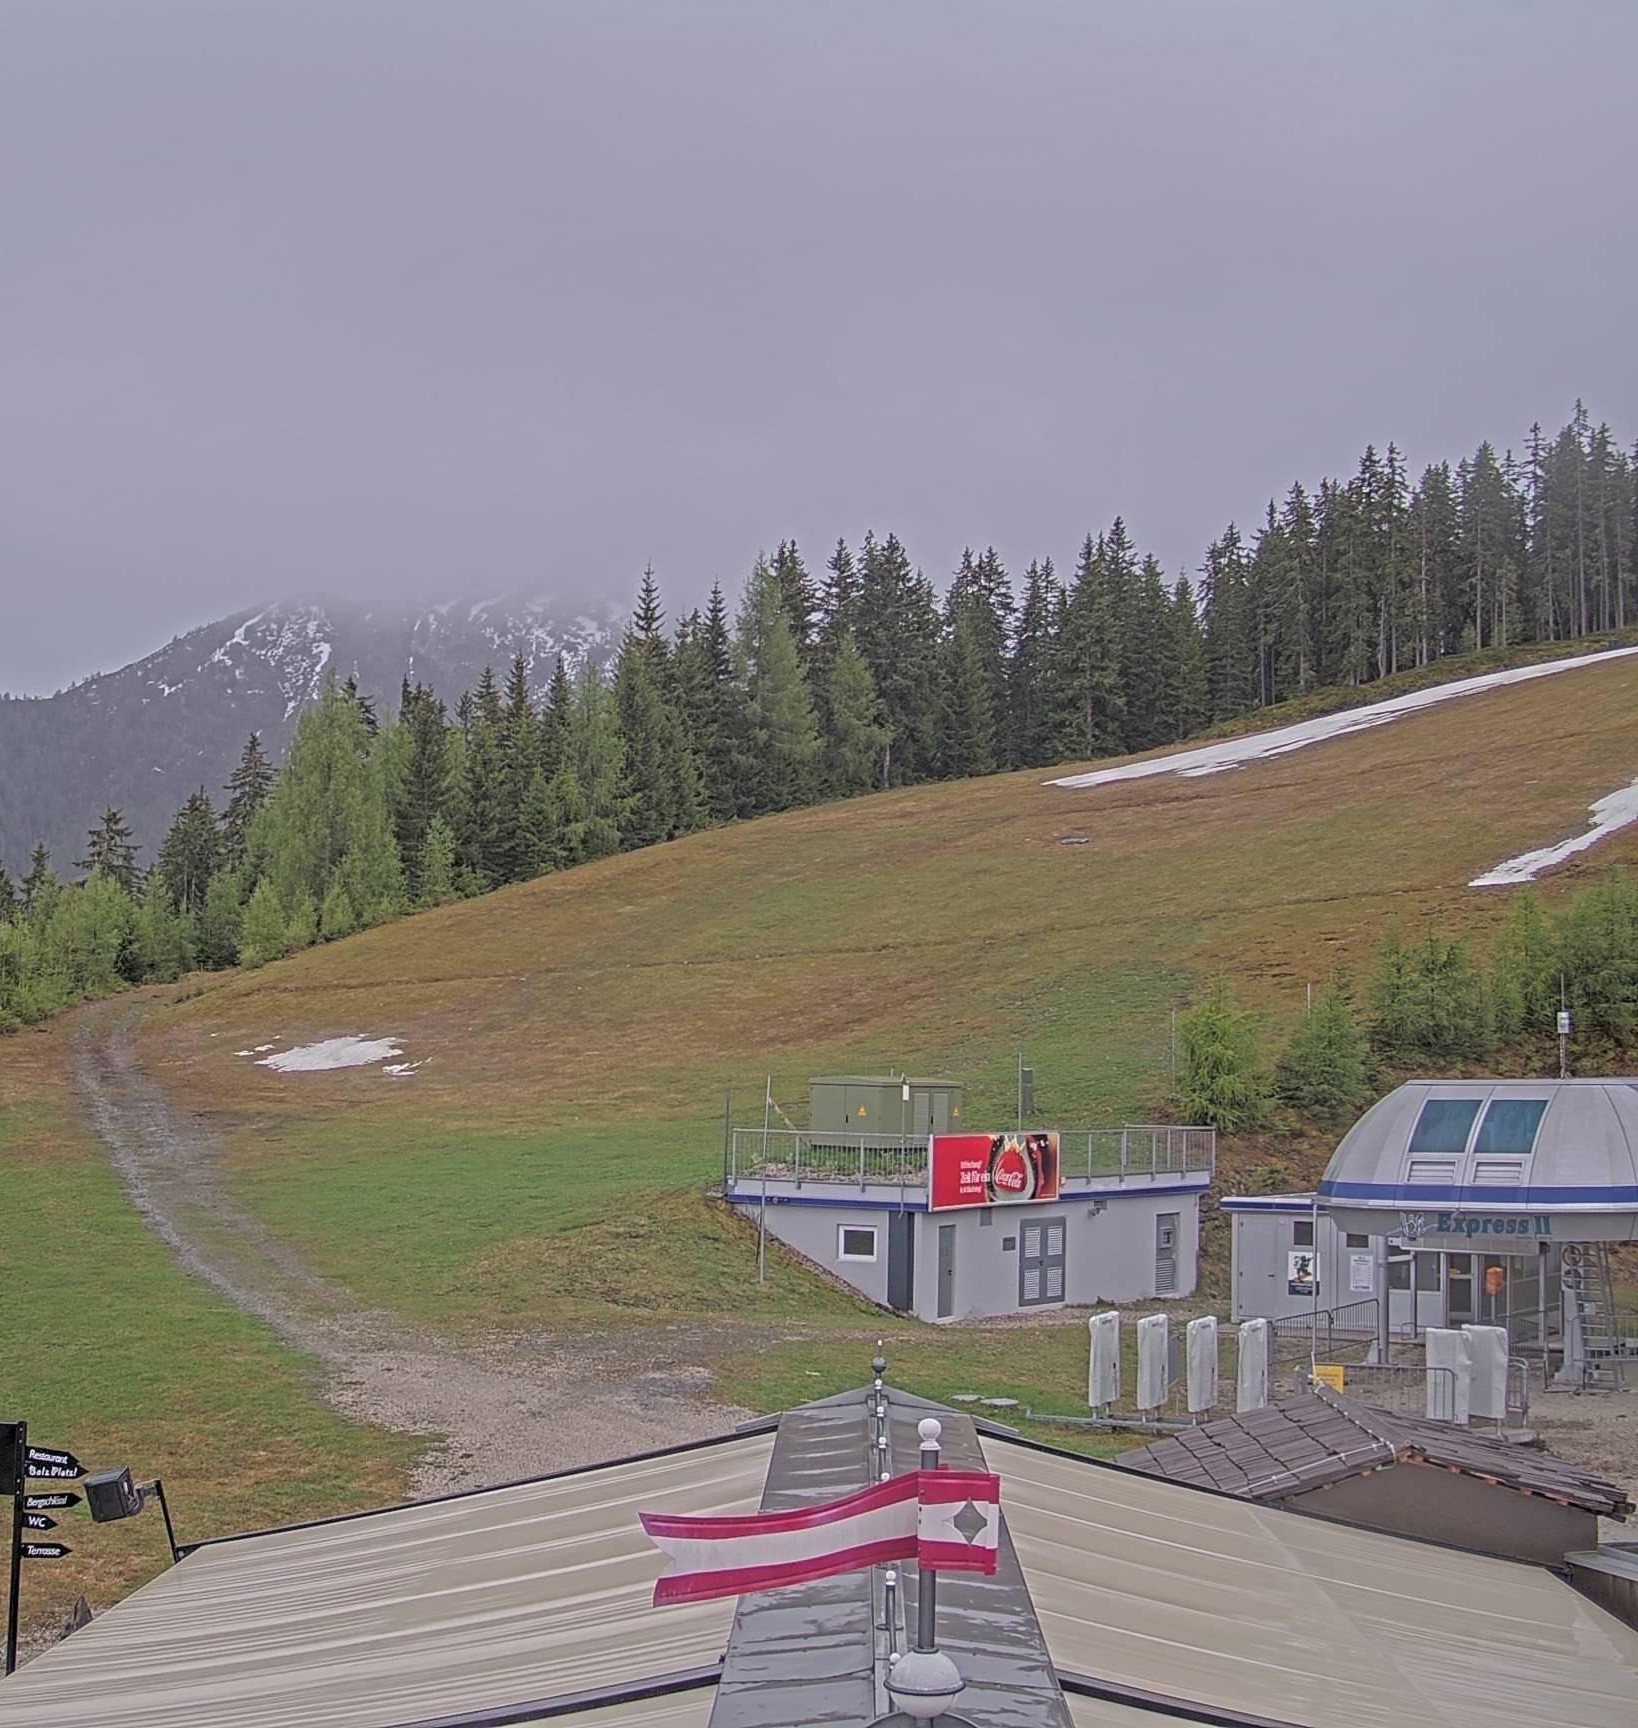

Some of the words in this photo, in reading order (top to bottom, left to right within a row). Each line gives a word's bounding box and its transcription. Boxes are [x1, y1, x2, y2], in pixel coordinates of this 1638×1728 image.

[1436, 1212, 1529, 1238] Express
[29, 1449, 68, 1464] Restaurant
[28, 1516, 47, 1528] WC
[27, 1545, 61, 1556] Terrasse
